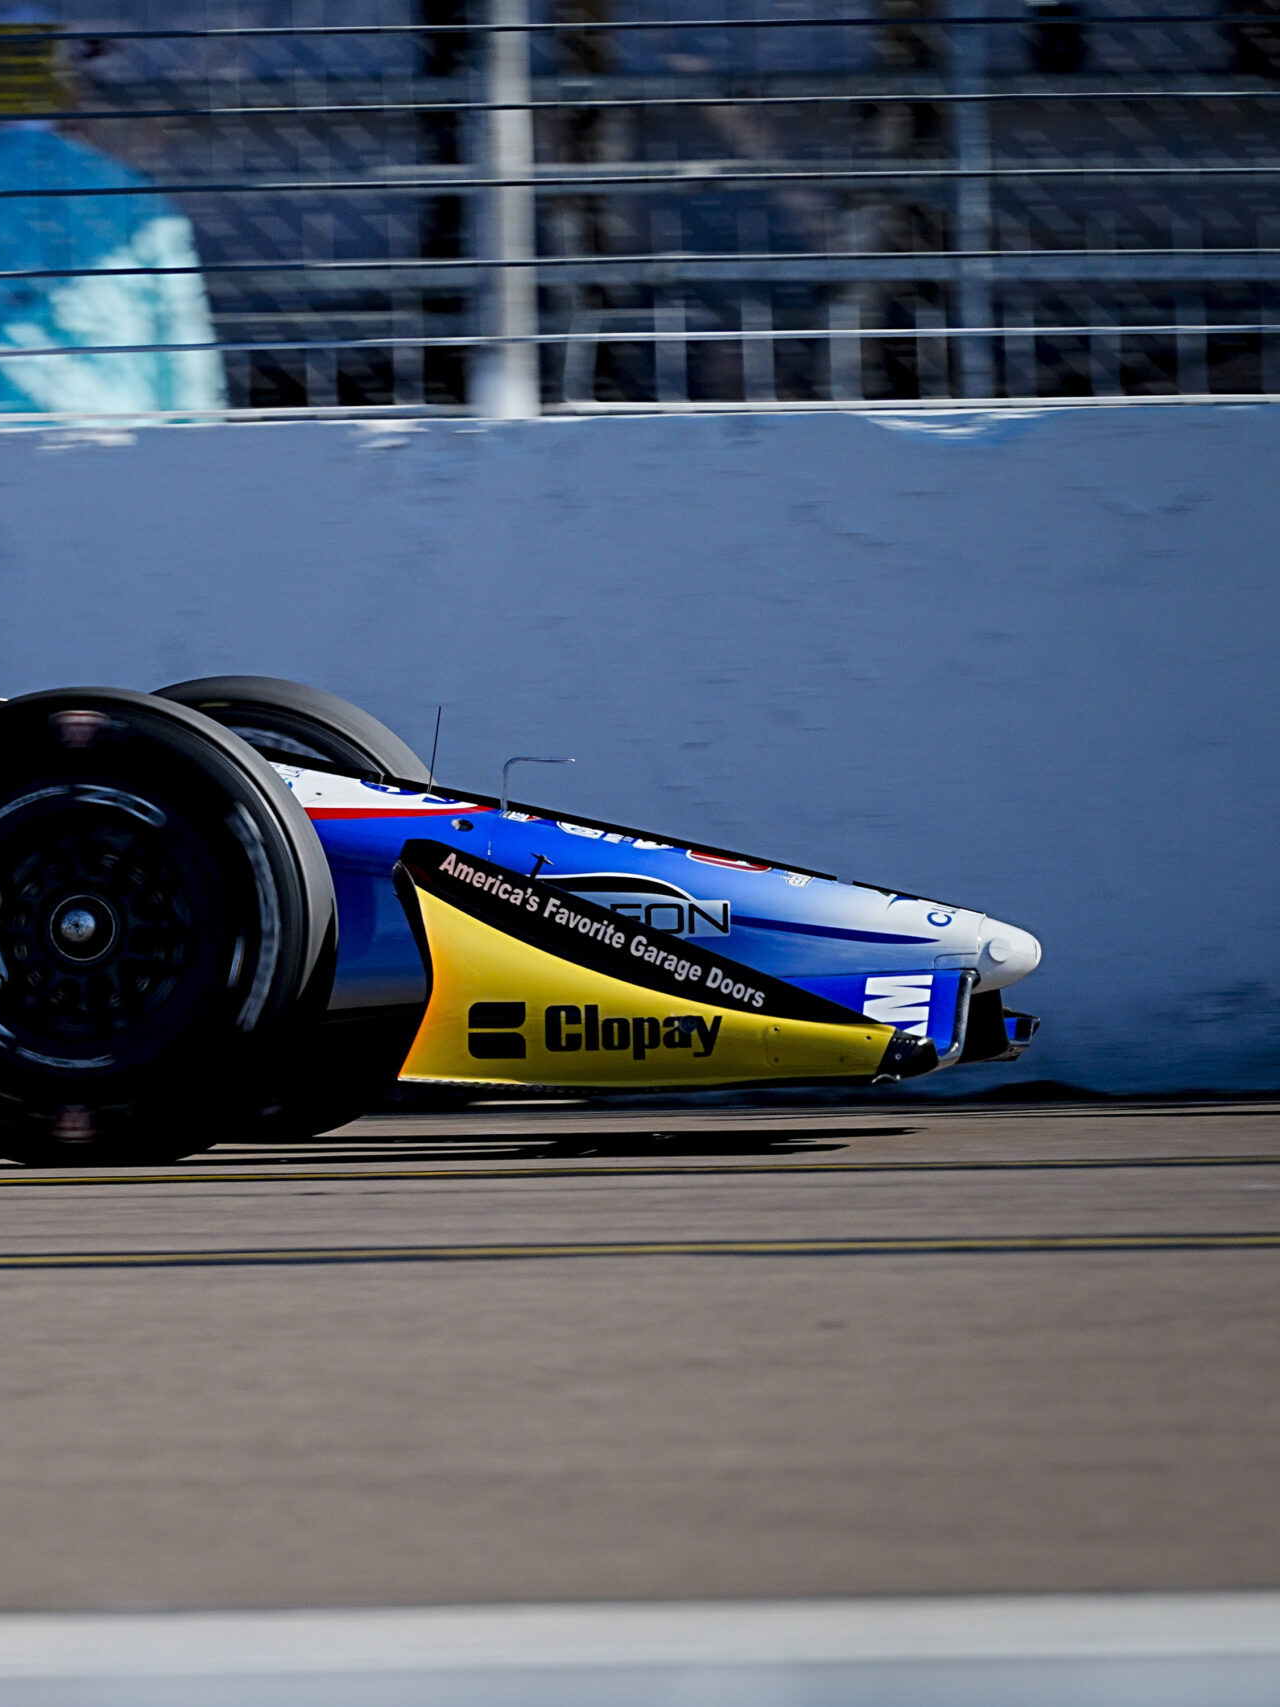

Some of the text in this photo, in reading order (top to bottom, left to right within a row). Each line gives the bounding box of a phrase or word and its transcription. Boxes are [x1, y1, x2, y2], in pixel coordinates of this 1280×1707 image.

[439, 852, 766, 1008] America's Favorite Garage Doors
[544, 1003, 723, 1061] Clopay
